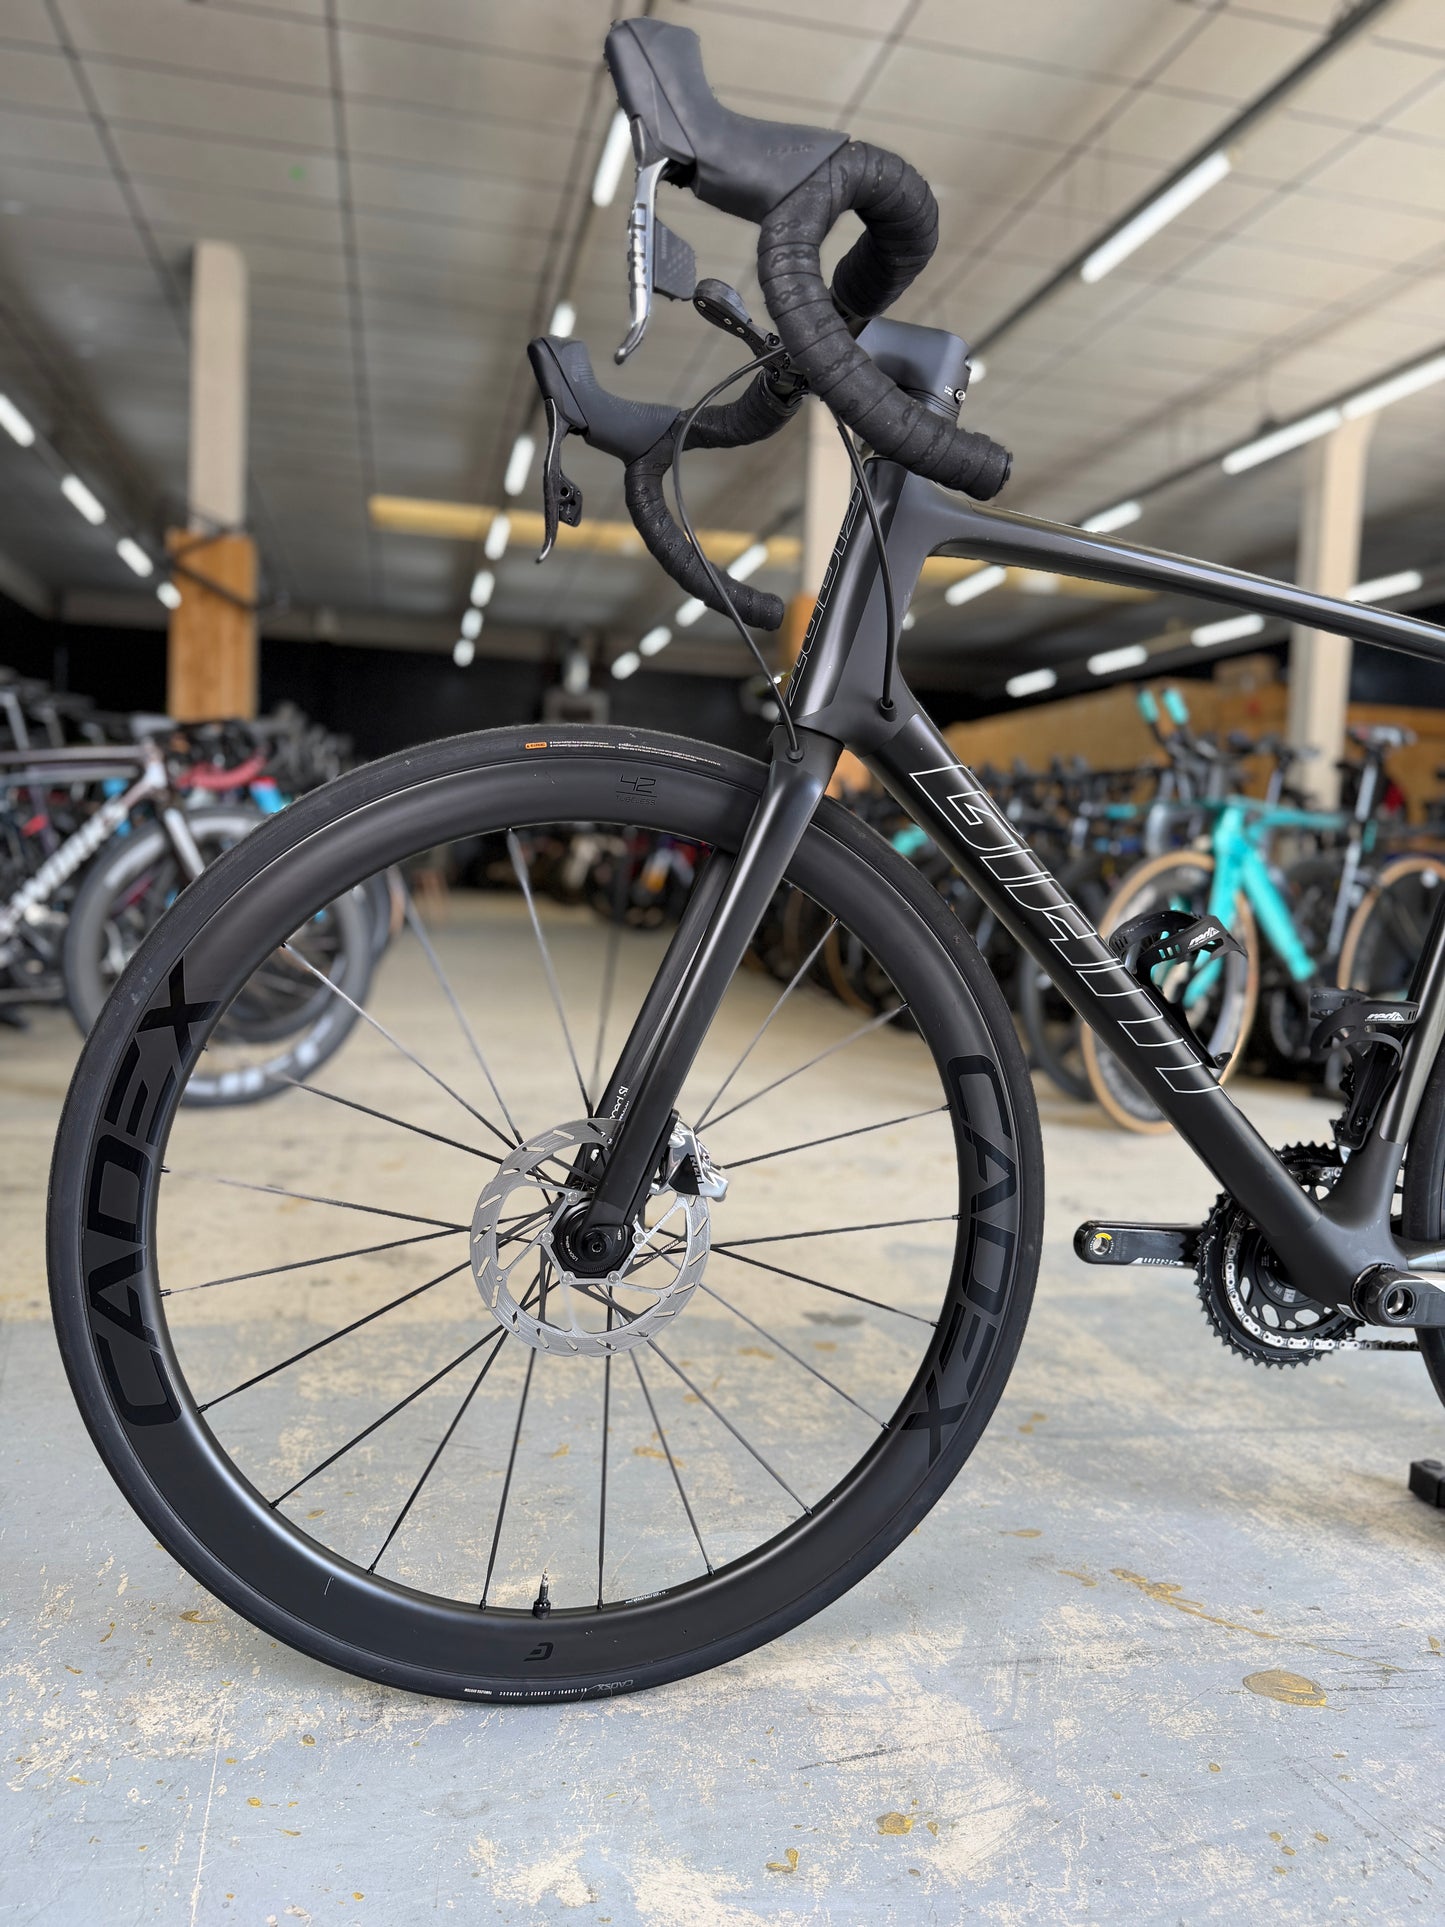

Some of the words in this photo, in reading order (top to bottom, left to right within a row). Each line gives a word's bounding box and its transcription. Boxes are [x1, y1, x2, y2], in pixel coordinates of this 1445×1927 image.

[620, 774, 657, 794] 42
[87, 956, 220, 1426] CADEX
[901, 1053, 1017, 1468] CADEX
